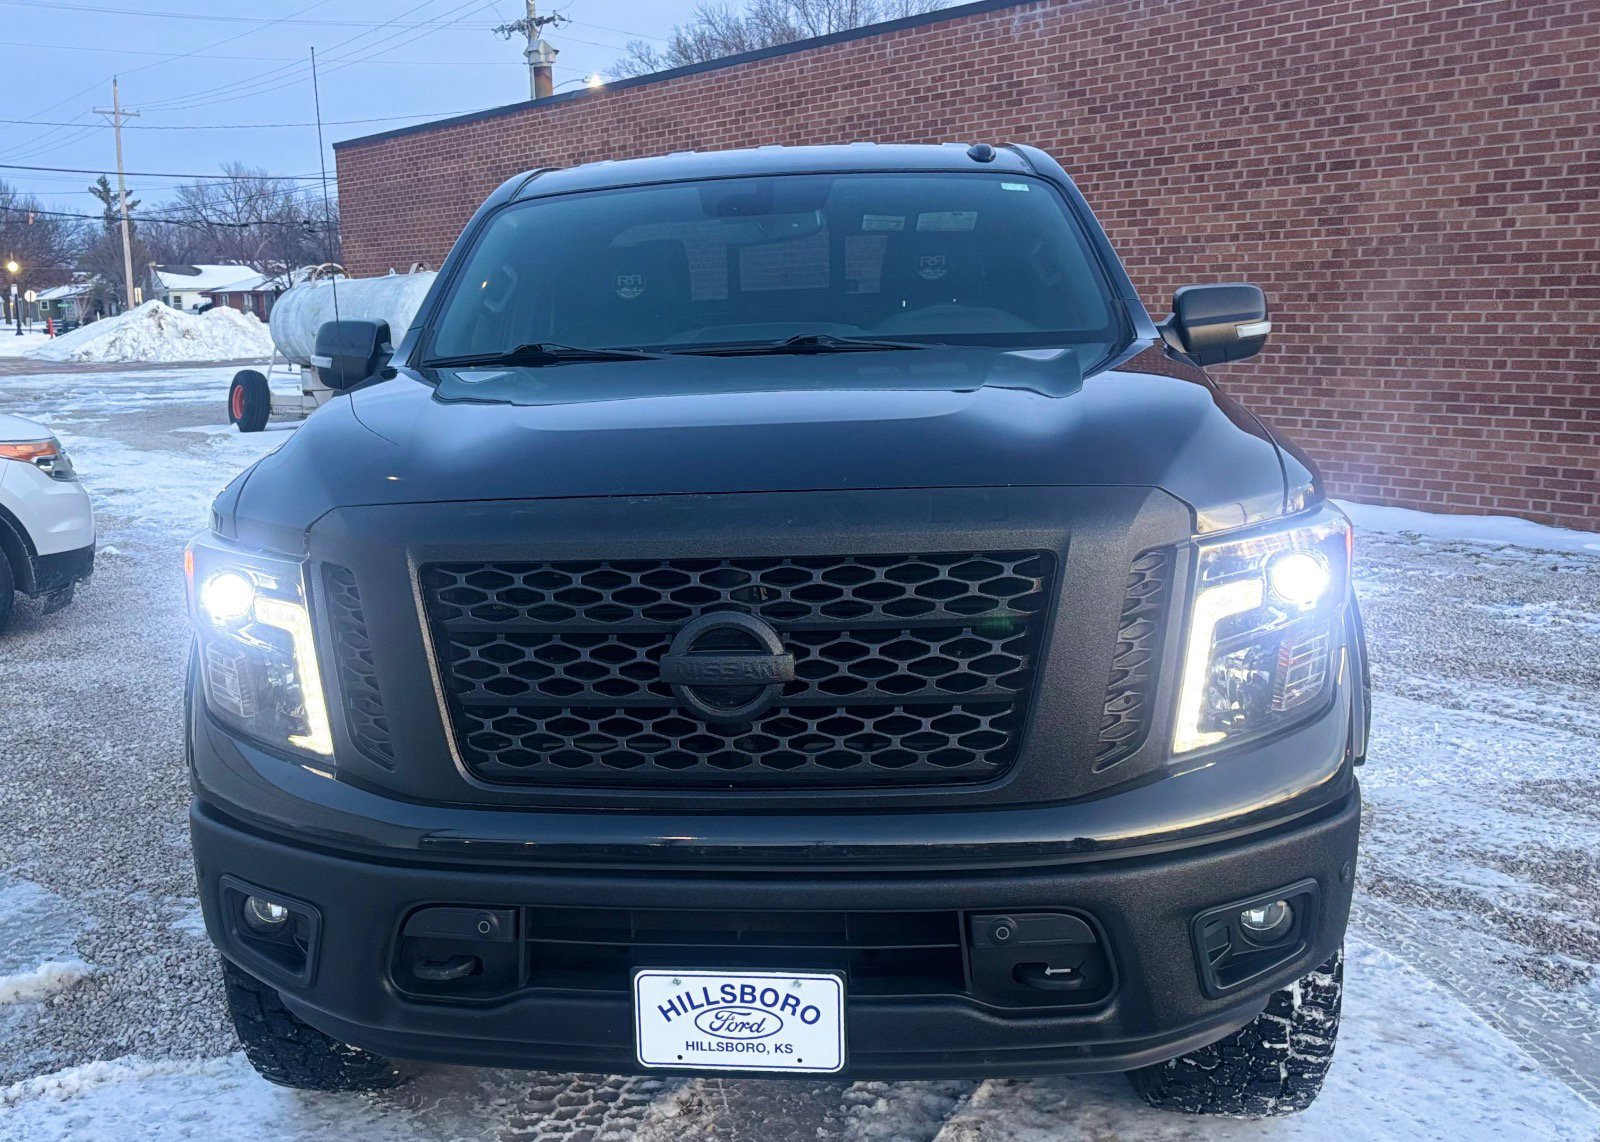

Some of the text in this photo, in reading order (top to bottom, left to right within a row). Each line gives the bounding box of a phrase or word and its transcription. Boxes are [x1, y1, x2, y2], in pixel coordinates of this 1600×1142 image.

[675, 661, 779, 680] NISSAN
[657, 983, 821, 1025] HILLSBORO
[708, 1010, 767, 1034] Ford
[685, 1040, 794, 1055] HILLSBORO, KS
